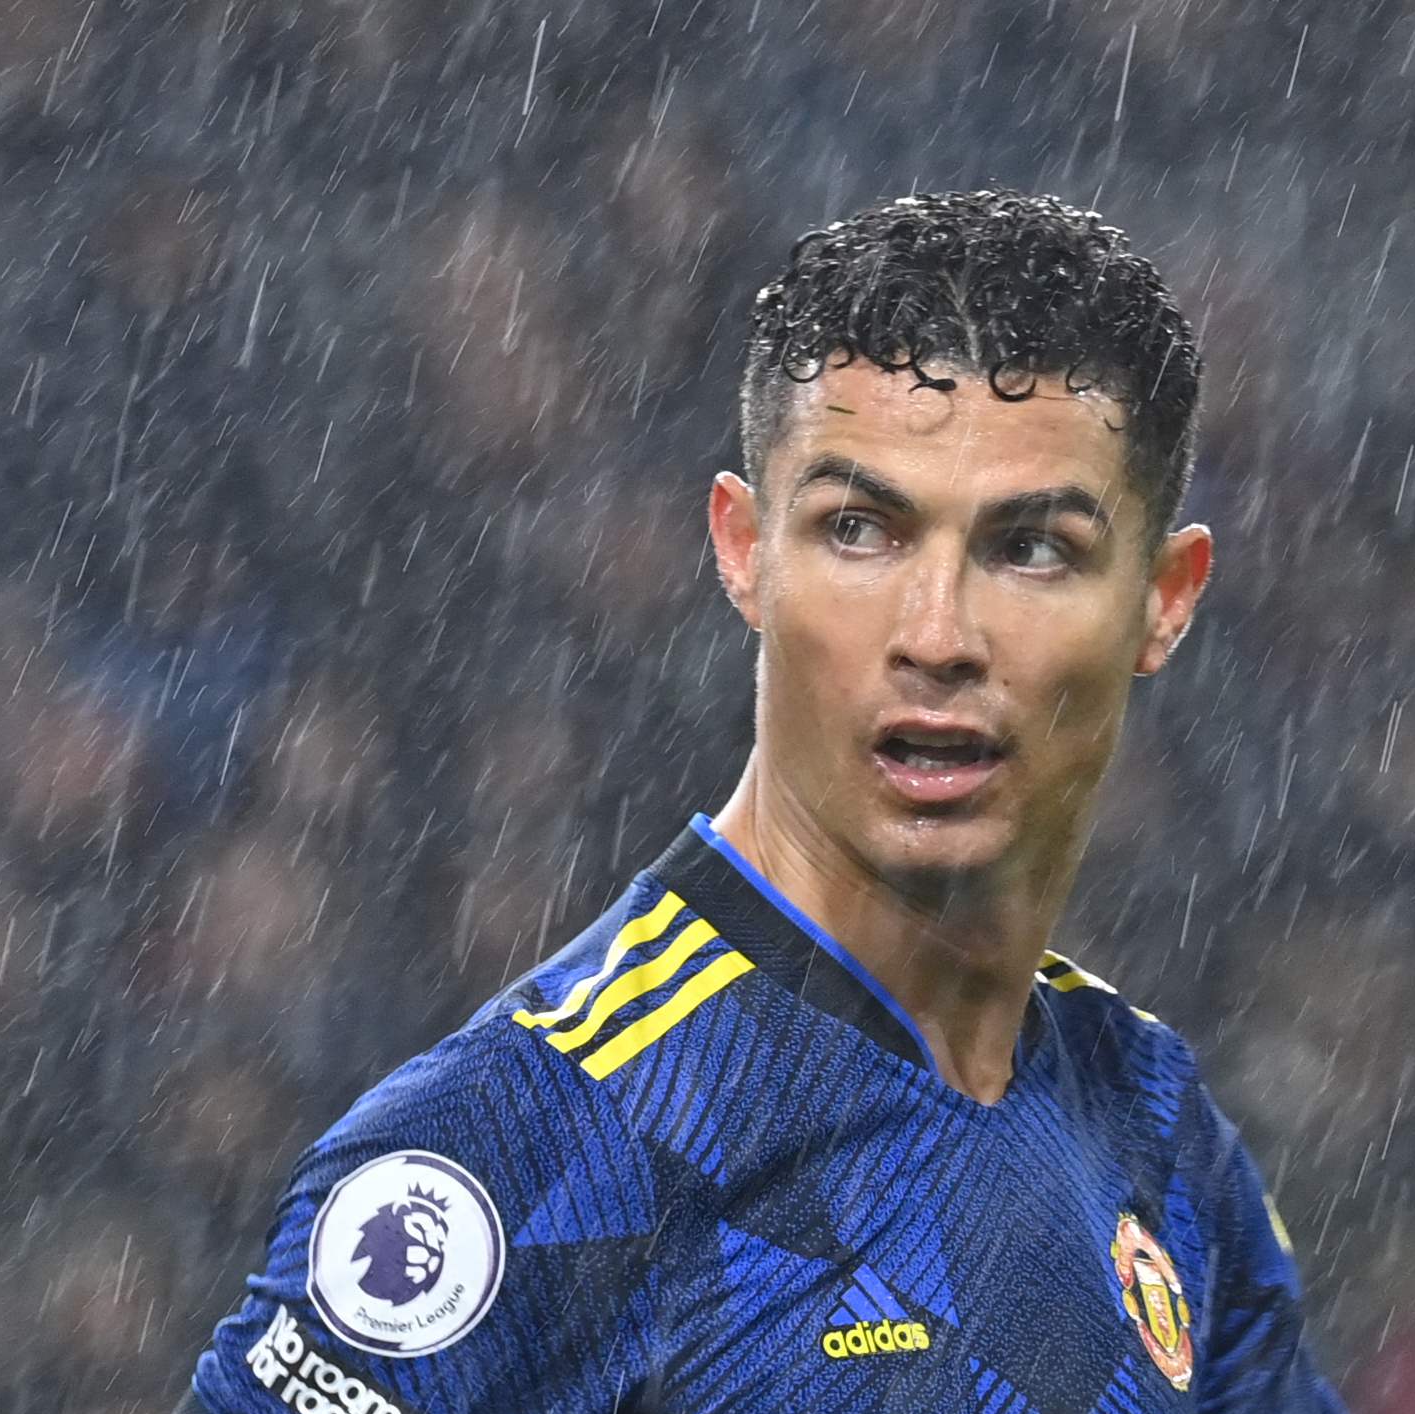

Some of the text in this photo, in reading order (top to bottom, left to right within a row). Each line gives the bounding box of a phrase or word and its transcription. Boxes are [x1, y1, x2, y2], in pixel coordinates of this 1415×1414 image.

[266, 1303, 305, 1364] No
[355, 1283, 466, 1334] Premier League
[246, 1333, 290, 1389] for
[822, 1319, 931, 1360] adidas
